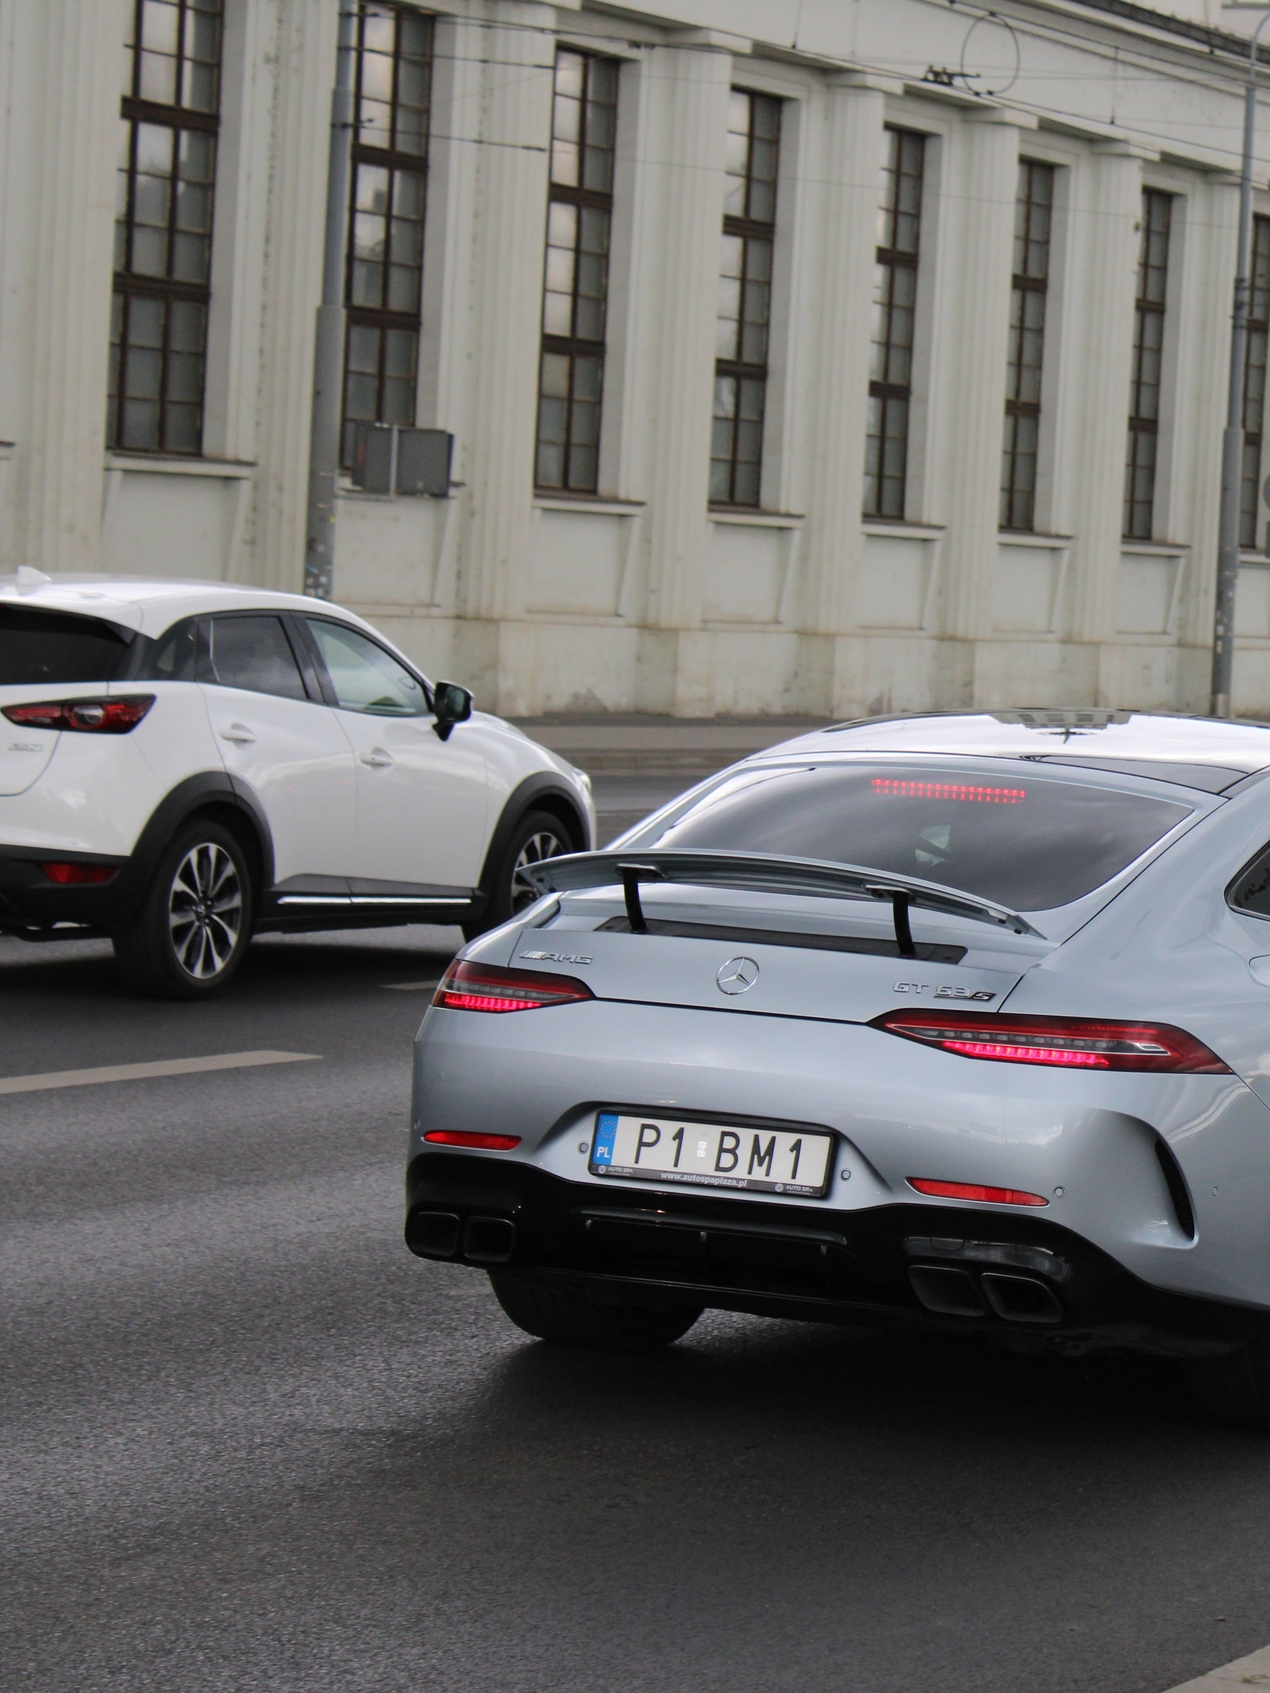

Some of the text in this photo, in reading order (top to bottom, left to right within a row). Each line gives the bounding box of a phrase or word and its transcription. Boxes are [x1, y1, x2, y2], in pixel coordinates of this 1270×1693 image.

[541, 952, 593, 965] AMG
[893, 981, 929, 994] GT
[596, 1146, 611, 1158] PL
[634, 1123, 803, 1180] P1 BM1
[660, 1171, 748, 1188] www.autospaplaza.pl
